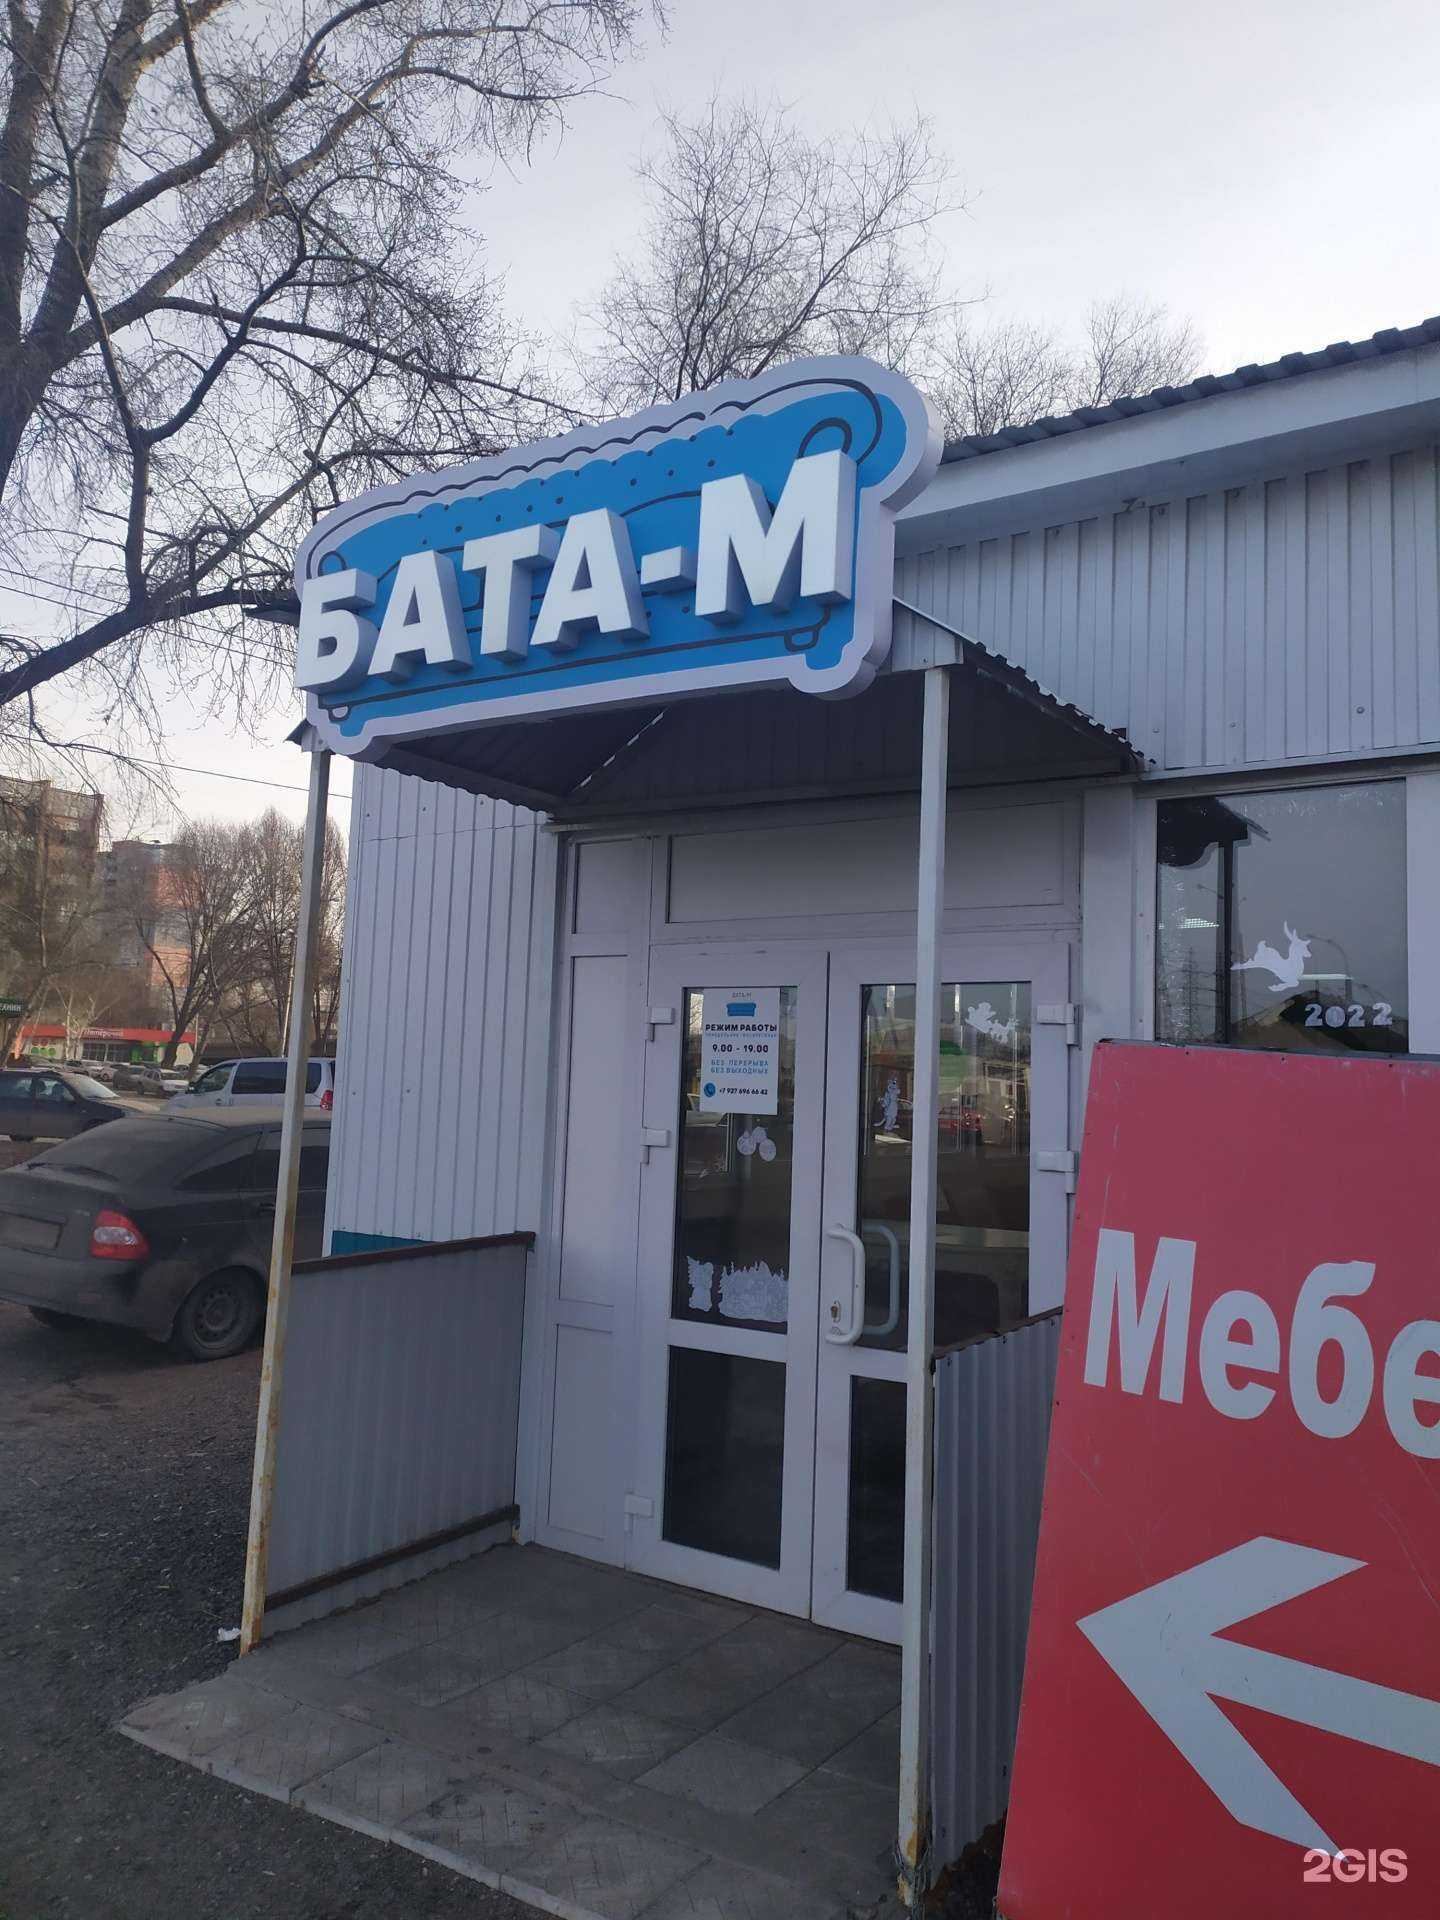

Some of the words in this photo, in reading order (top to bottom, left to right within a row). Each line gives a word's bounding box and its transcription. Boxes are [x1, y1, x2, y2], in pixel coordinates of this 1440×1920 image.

[294, 448, 858, 696] БАТА-М
[1304, 1002, 1393, 1027] 2022
[705, 1023, 739, 1032] РЕЖИМ
[740, 1023, 777, 1032] РАБОТЫ
[712, 1043, 733, 1053] 9.00
[743, 1044, 769, 1053] 19.00
[1084, 1228, 1440, 1459] Мебе
